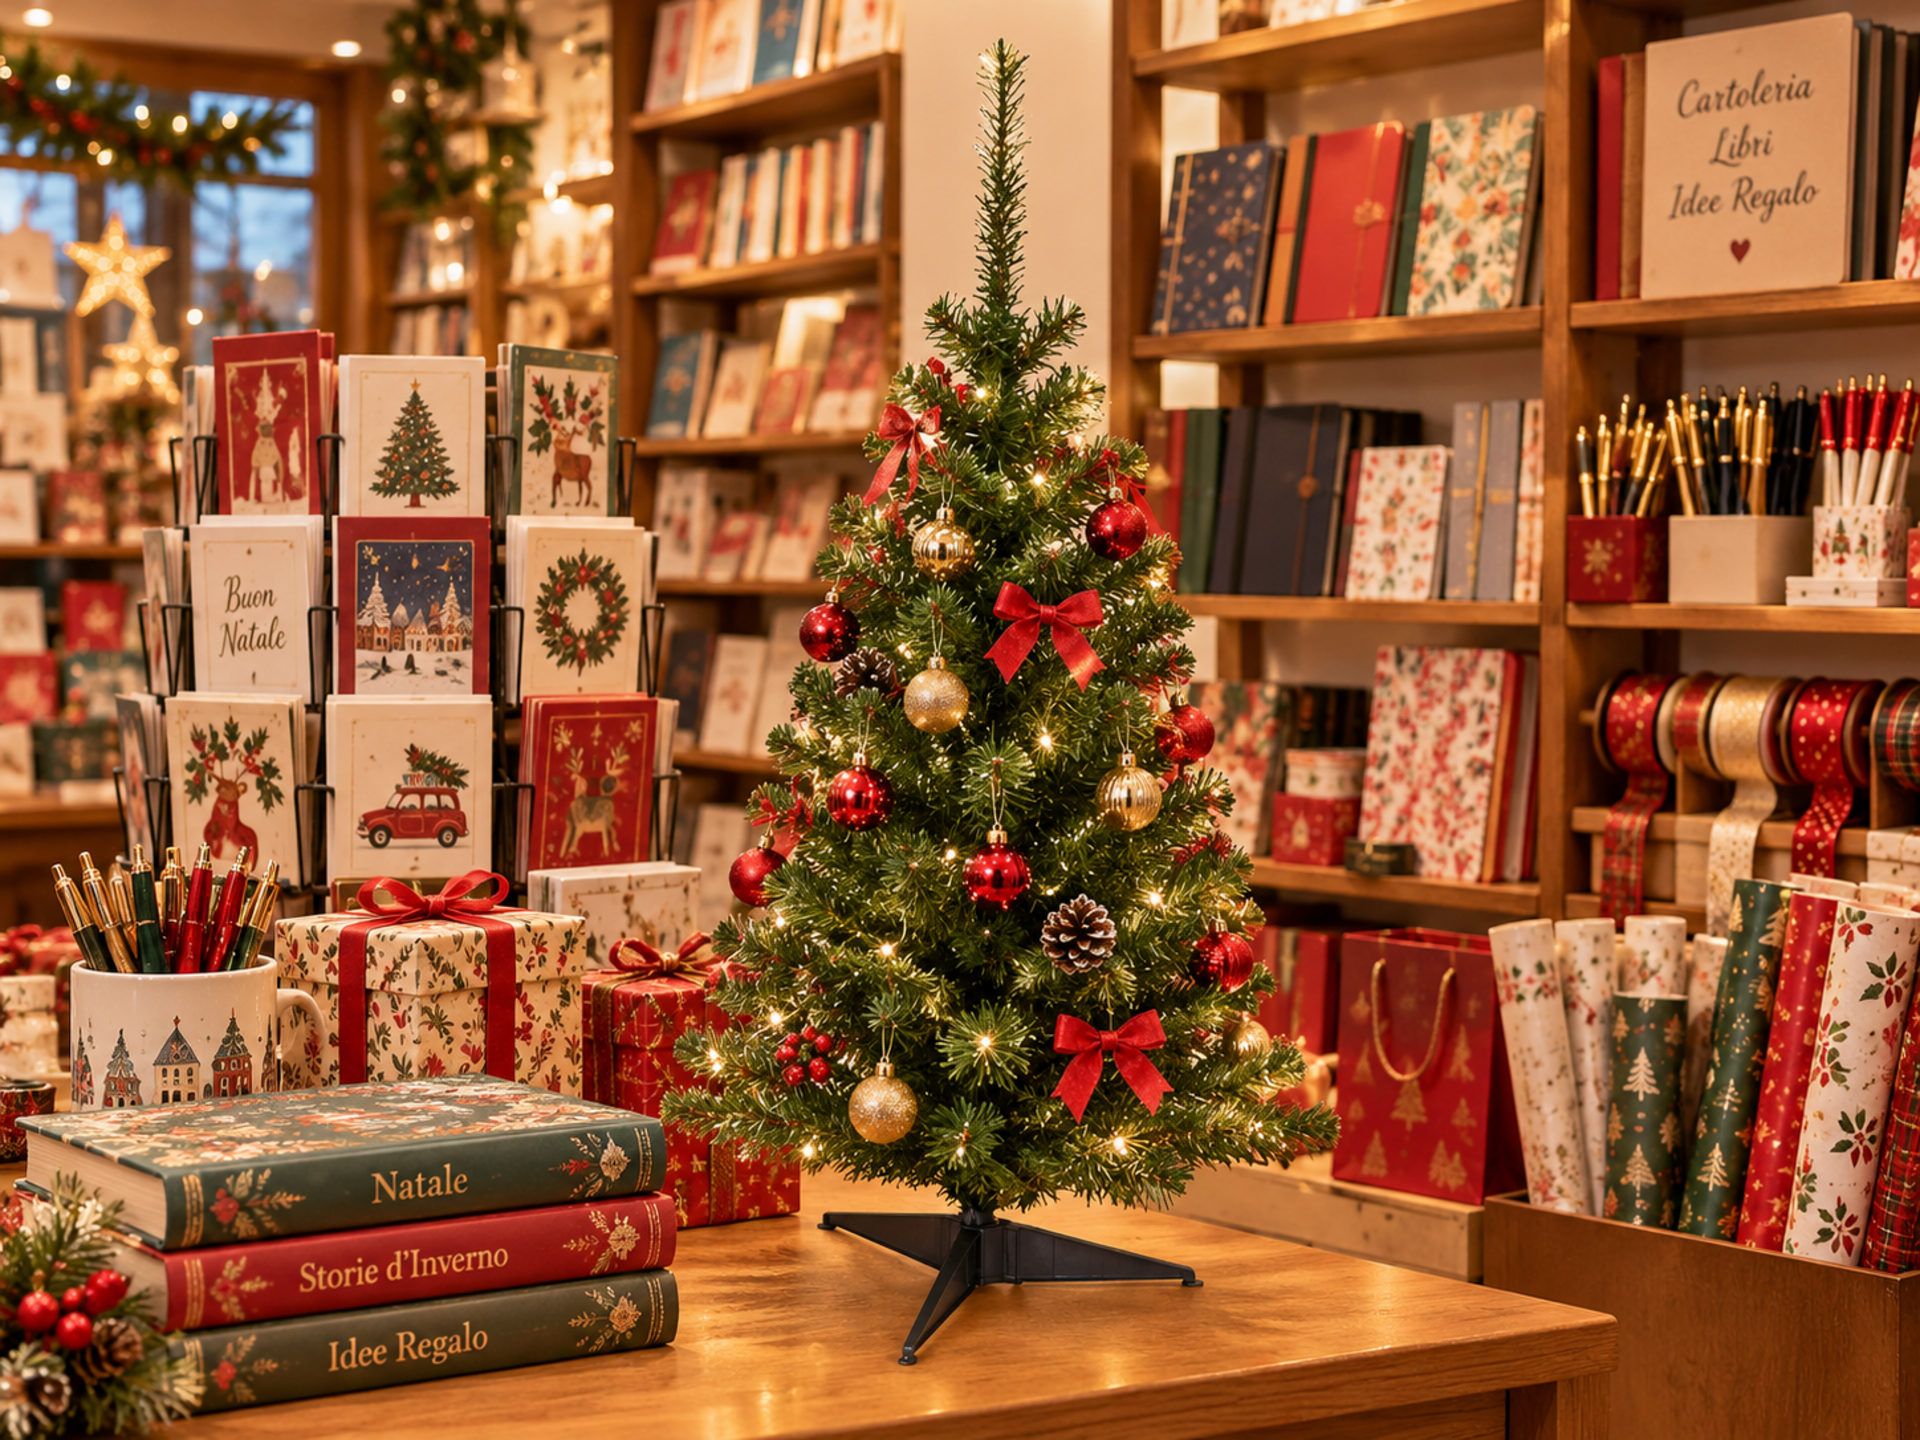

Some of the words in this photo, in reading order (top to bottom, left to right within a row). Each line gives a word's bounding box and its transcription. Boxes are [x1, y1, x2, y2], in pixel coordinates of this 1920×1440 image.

[1677, 68, 1815, 119] Cartoleria
[1709, 123, 1774, 168] Libri
[1668, 182, 1722, 220] Idee
[1731, 169, 1820, 224] Regalo
[223, 574, 278, 614] Buon
[218, 615, 287, 658] Natale
[371, 1163, 469, 1204] Natale
[299, 1257, 379, 1292] Storie
[386, 1248, 509, 1281] d’Inverno
[328, 1337, 388, 1372] Idee
[395, 1320, 489, 1365] Regalo
